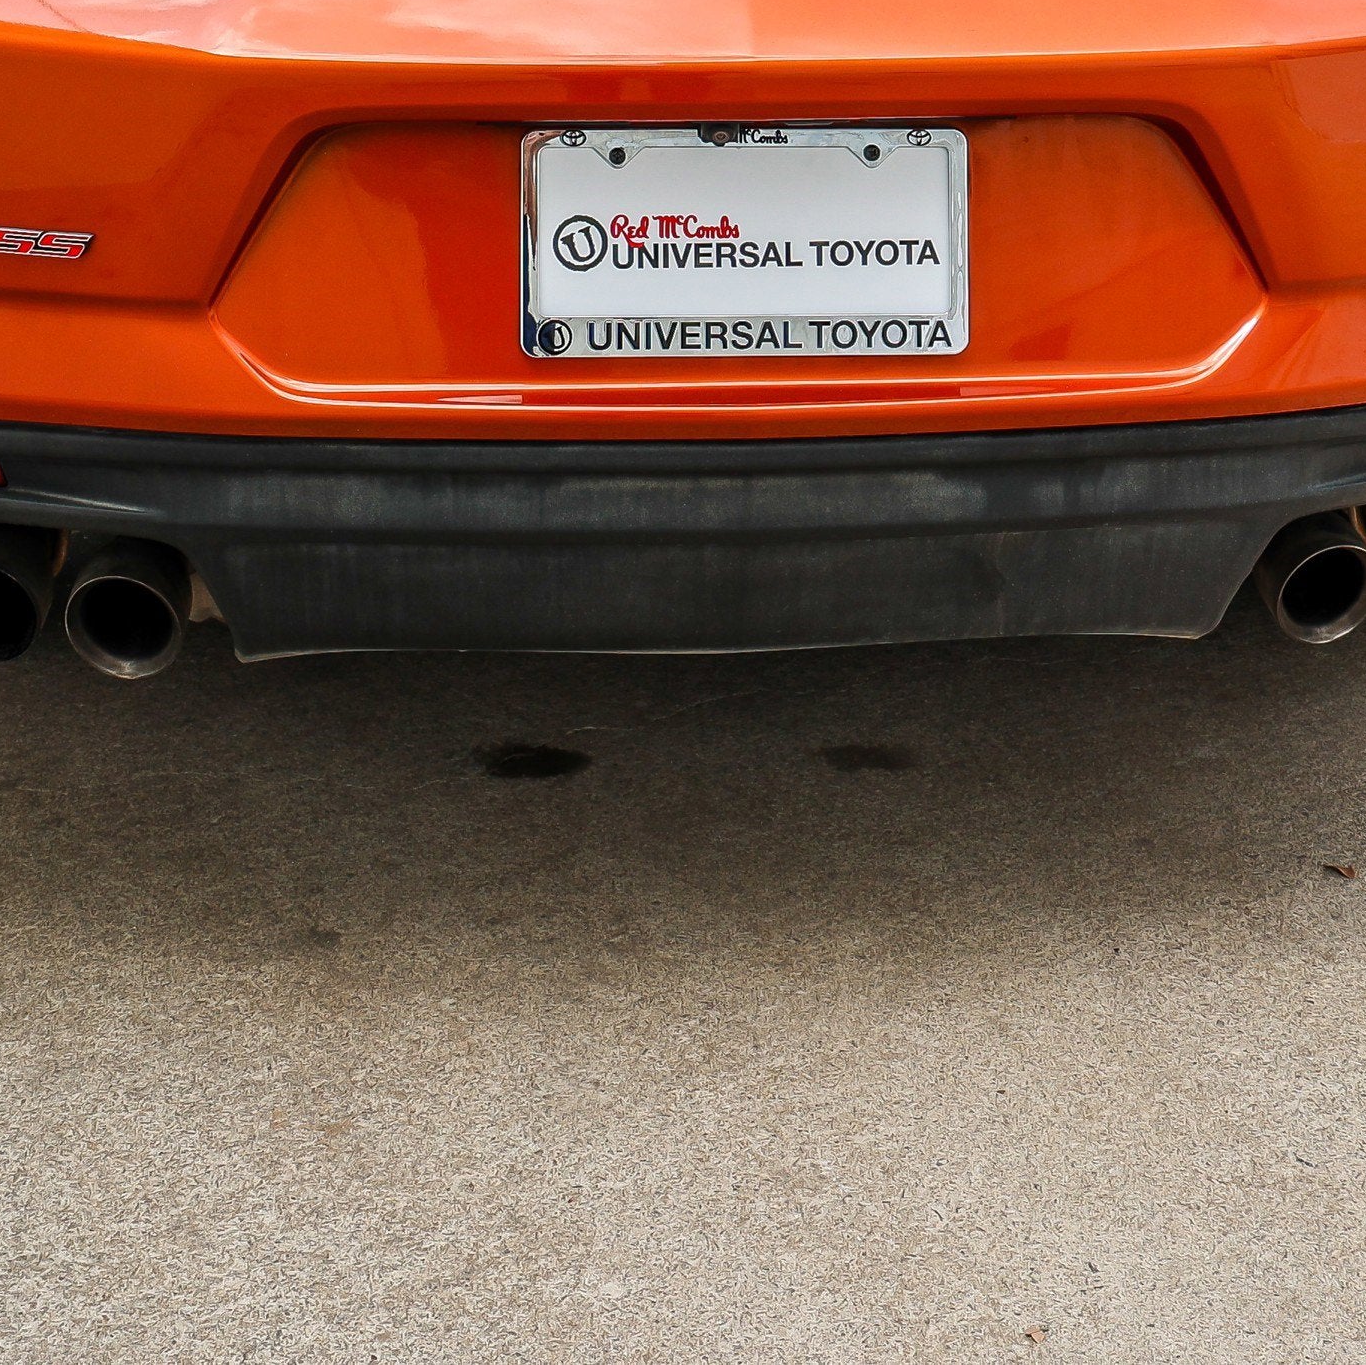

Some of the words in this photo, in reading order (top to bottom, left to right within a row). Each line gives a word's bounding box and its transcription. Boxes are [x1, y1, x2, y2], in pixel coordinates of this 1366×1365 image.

[612, 241, 803, 269] UNIVERSAL
[809, 240, 940, 266] TOYOTA
[588, 321, 802, 350] UNIVERSAL
[803, 320, 953, 349] TOYOTA
